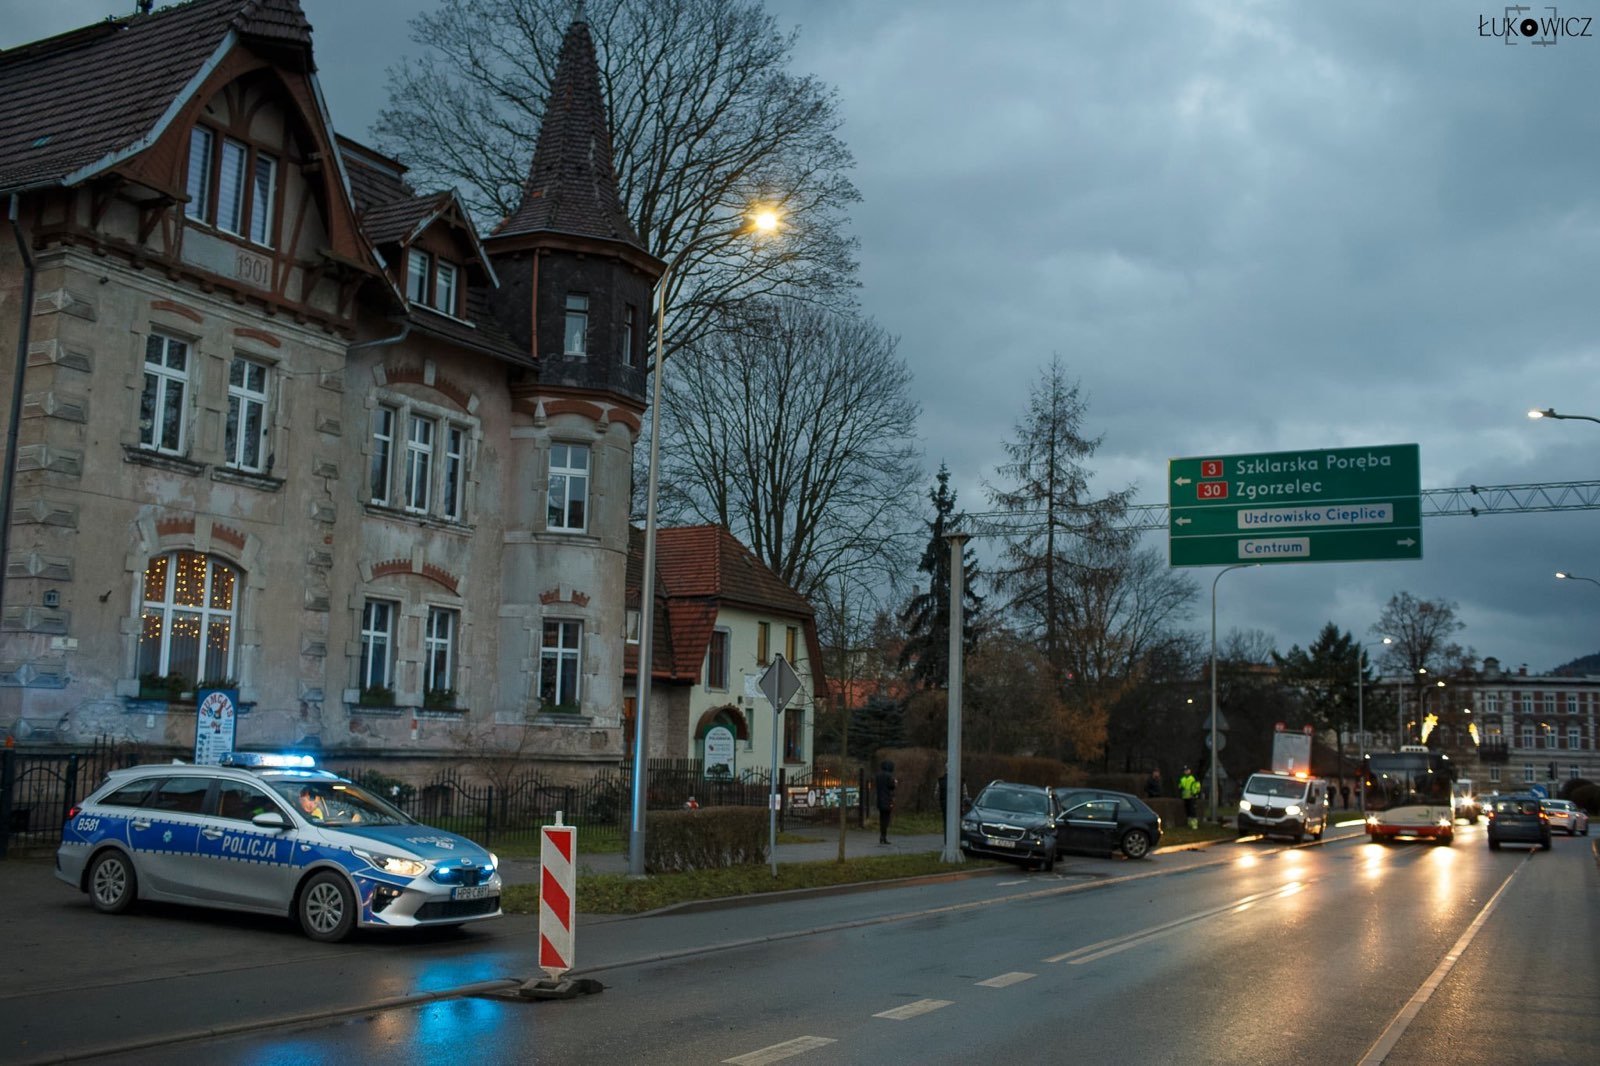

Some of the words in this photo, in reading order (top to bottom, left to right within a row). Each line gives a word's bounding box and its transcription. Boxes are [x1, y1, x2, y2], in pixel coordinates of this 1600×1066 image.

[237, 254, 268, 284] 1901
[1207, 463, 1216, 475] 3
[1236, 455, 1318, 475] Szklarska
[1327, 452, 1391, 471] Poręba
[1204, 485, 1221, 496] 30
[1236, 479, 1322, 499] Zgorzelec
[1244, 508, 1321, 525] Uzdrowisko
[1326, 507, 1386, 521] Cieplice
[1244, 542, 1303, 555] Centrum
[77, 817, 99, 832] B581
[222, 835, 276, 858] POLICJA
